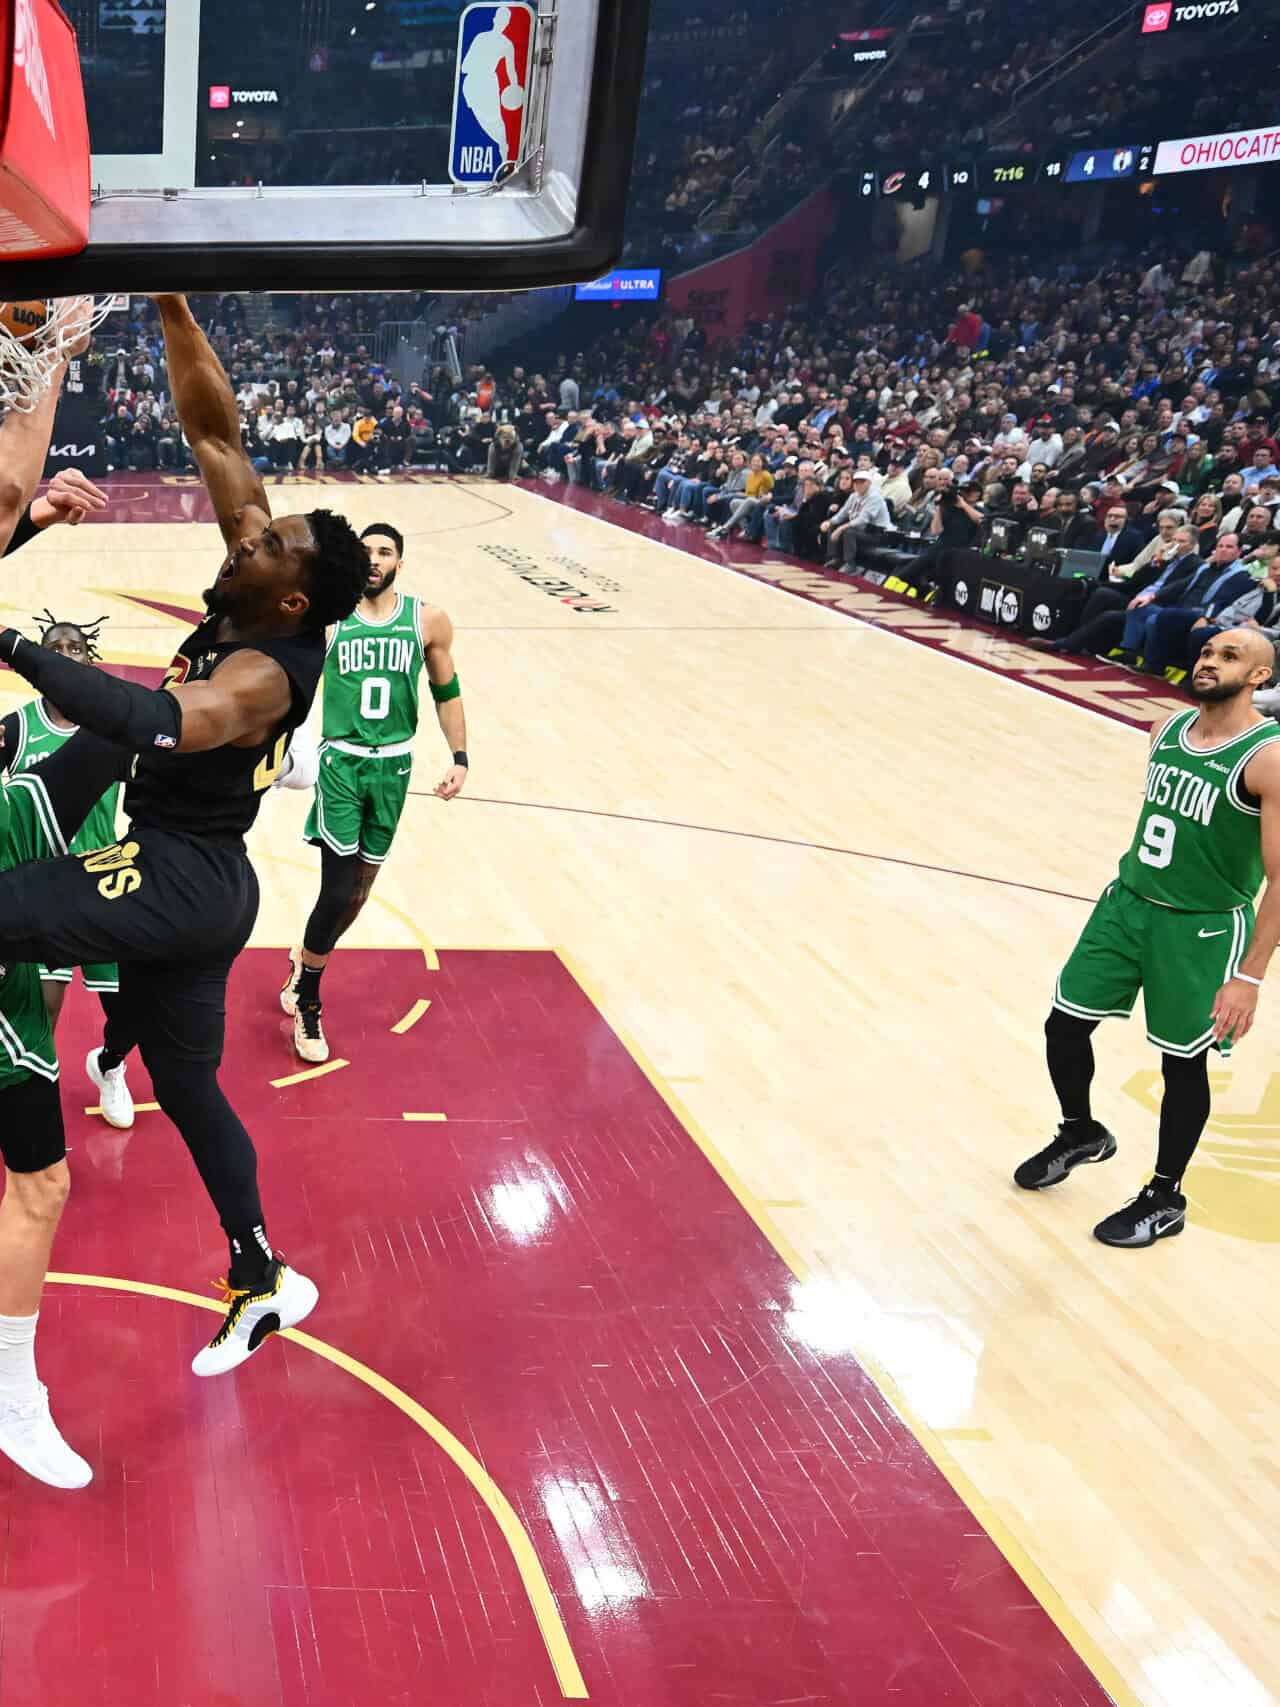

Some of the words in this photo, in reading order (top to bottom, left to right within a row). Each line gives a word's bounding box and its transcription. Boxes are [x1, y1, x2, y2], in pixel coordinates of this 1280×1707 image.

[1174, 0, 1239, 21] TOYOTA
[231, 90, 278, 103] TOYOTA
[460, 146, 493, 174] NBA
[1083, 156, 1095, 175] 4
[1139, 156, 1149, 170] 2
[918, 171, 930, 189] 4
[620, 279, 654, 290] ULTRA
[337, 637, 415, 675] BOSTON
[360, 677, 391, 720] 0
[1137, 813, 1177, 869] 9
